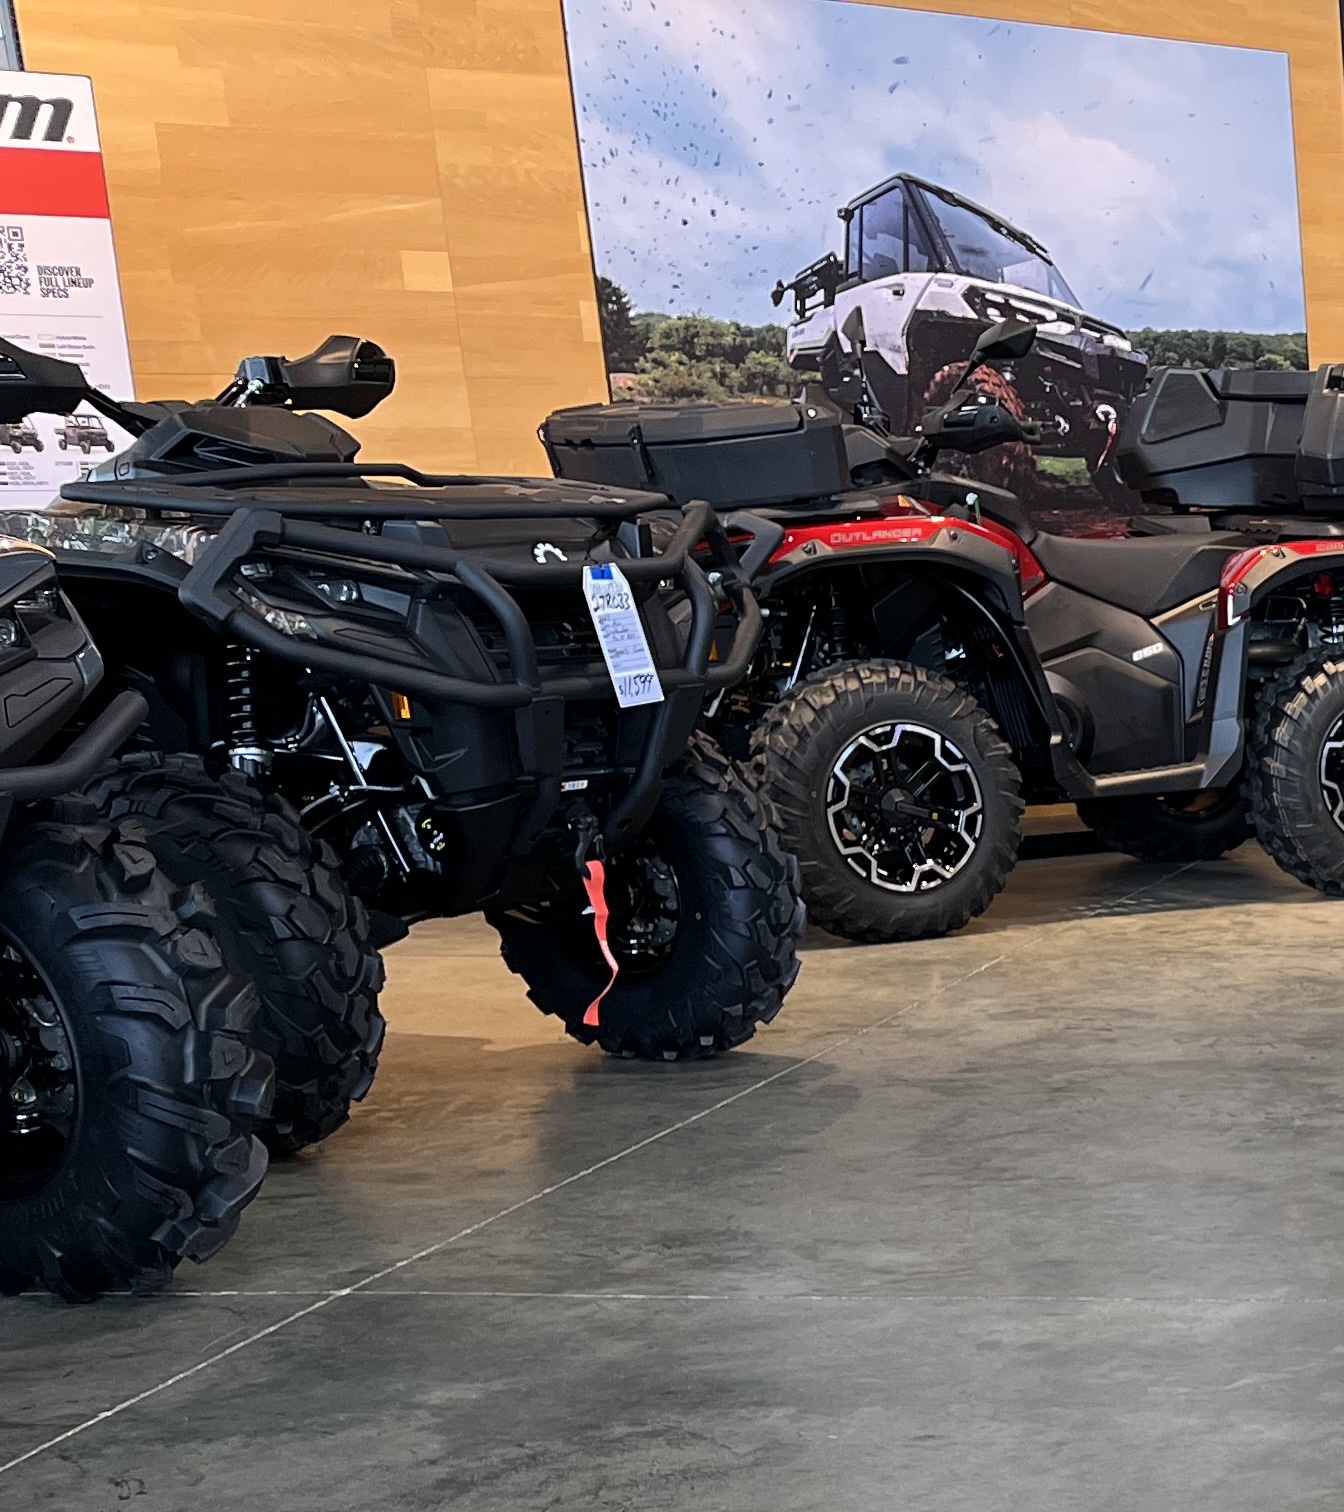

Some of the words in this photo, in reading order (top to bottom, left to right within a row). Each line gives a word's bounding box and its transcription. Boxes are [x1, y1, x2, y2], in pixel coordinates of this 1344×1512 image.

[36, 265, 82, 277] DISCOVER
[38, 276, 61, 288] FULL
[62, 277, 95, 288] LINEUP
[40, 287, 70, 298] SPECS
[830, 527, 923, 544] OUTLANDER
